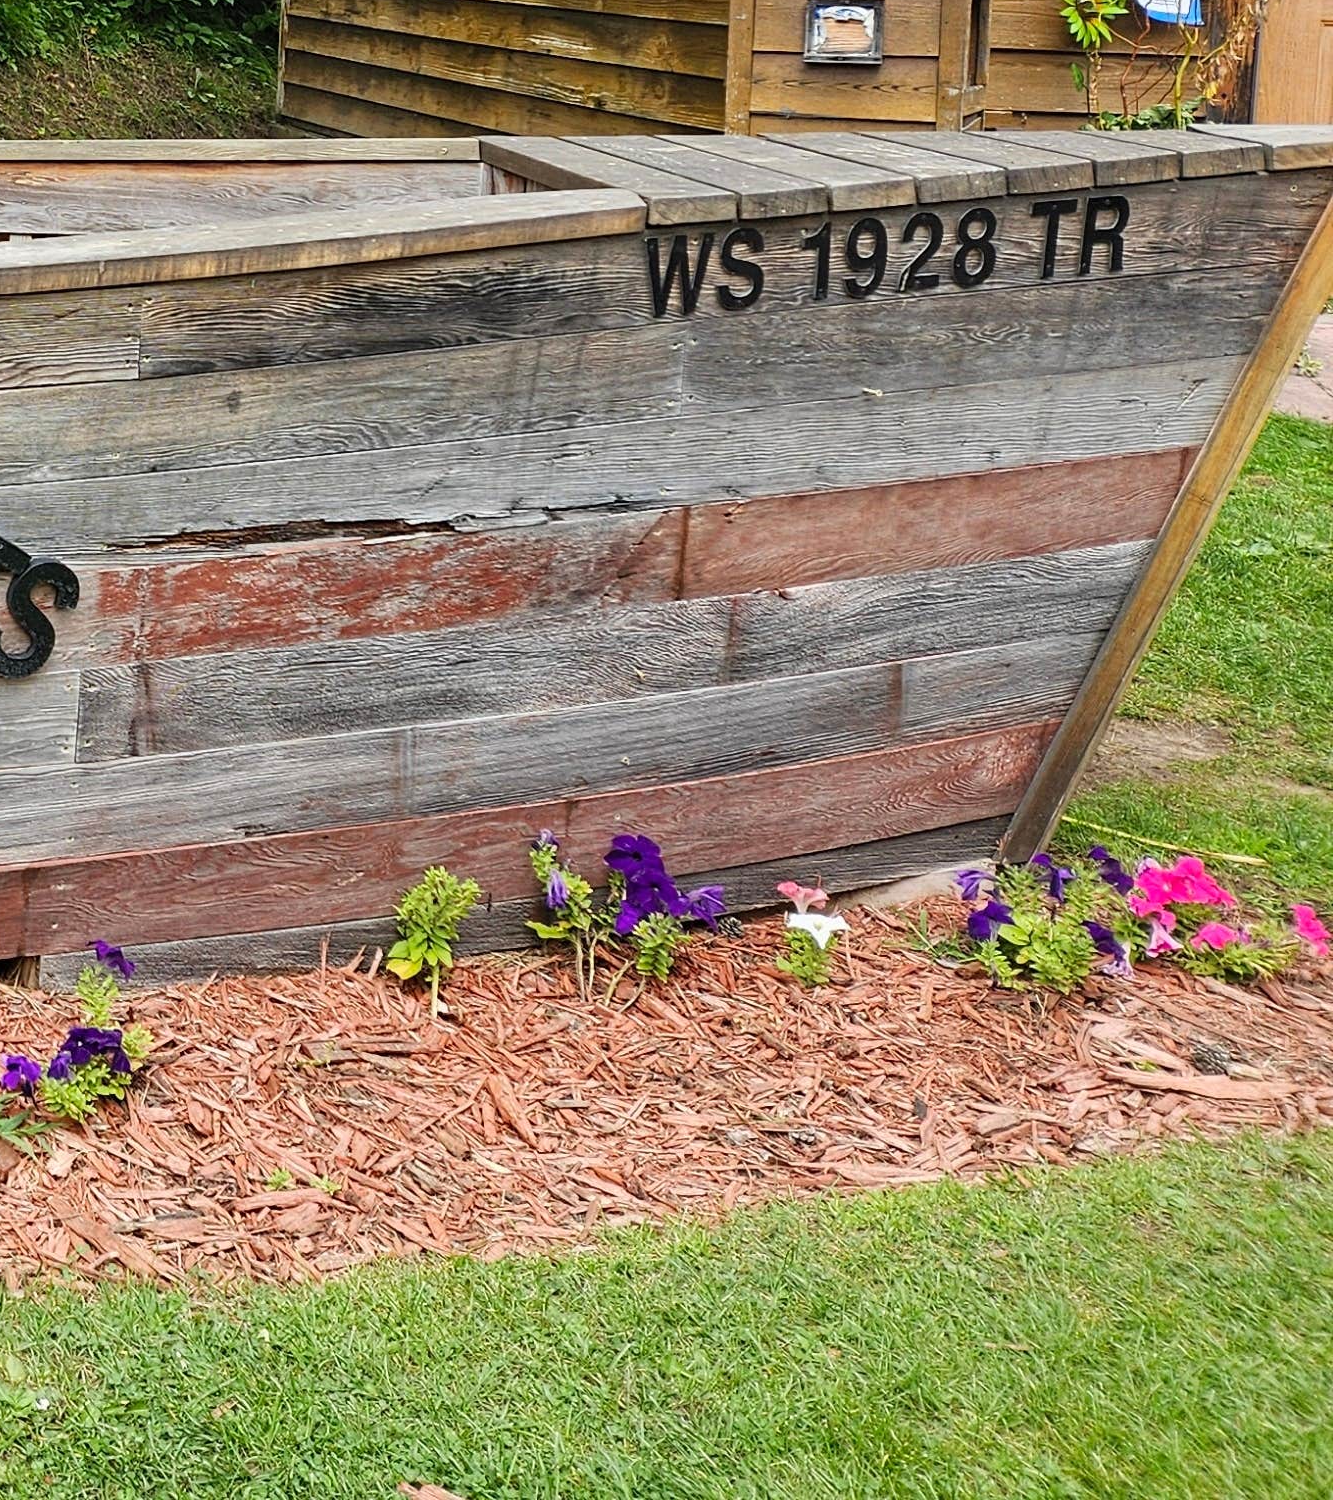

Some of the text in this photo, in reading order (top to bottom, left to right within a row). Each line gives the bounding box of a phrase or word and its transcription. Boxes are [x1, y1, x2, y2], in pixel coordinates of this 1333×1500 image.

[645, 195, 1131, 318] WS 1928 TR
